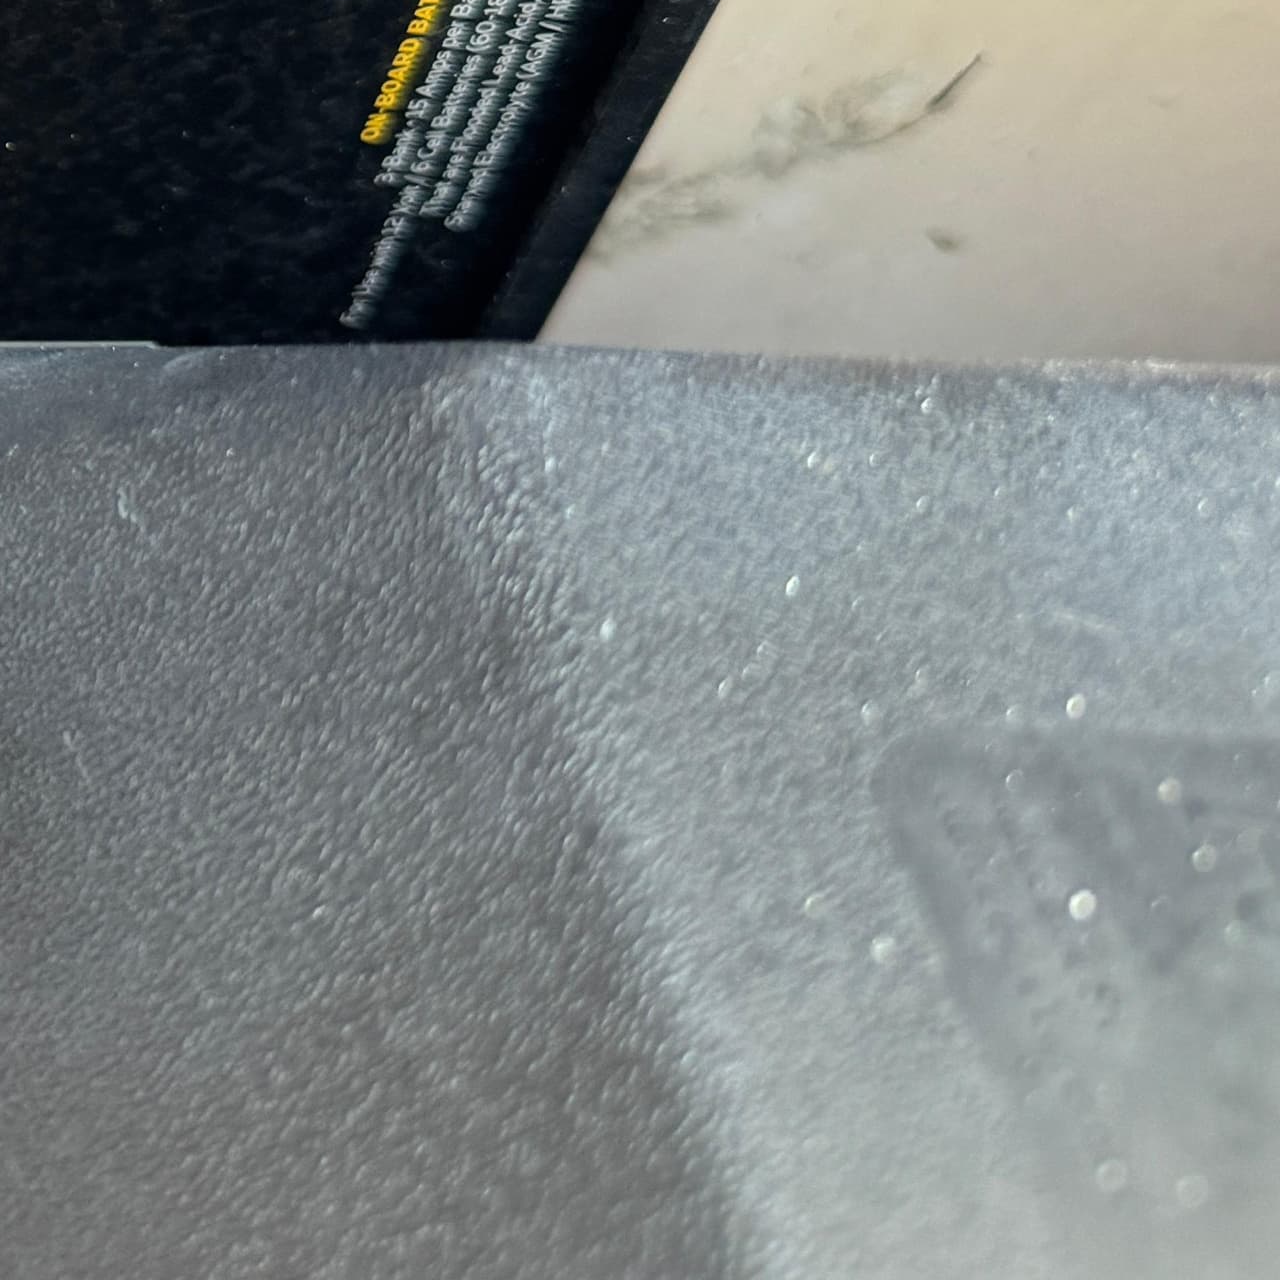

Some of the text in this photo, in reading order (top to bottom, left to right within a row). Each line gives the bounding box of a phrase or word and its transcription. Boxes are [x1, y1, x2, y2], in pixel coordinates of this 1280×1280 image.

[442, 20, 468, 49] per
[516, 33, 556, 81] (AGM
[360, 37, 425, 144] ON-BOARD
[416, 50, 453, 98] Amps
[430, 54, 487, 128] Batteries
[405, 98, 429, 121] 15
[418, 128, 449, 159] Cell
